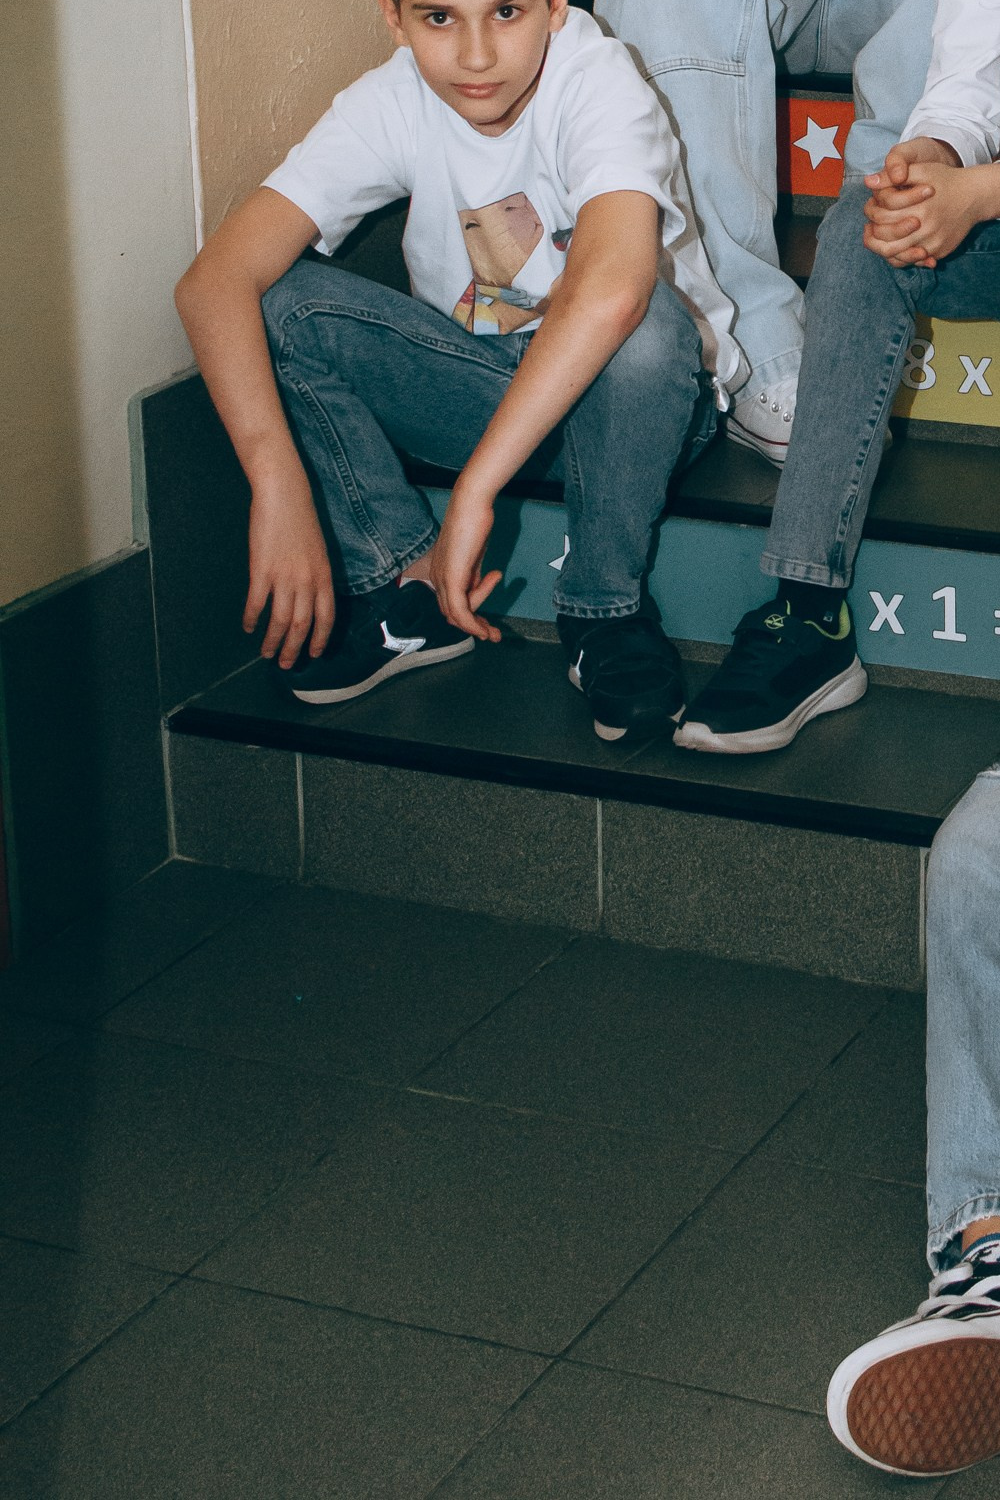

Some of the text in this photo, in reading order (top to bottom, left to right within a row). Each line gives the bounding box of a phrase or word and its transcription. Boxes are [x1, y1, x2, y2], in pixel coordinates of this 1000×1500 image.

[901, 338, 937, 390] 8
[957, 354, 993, 396] x
[868, 590, 906, 635] x
[931, 585, 967, 643] 1
